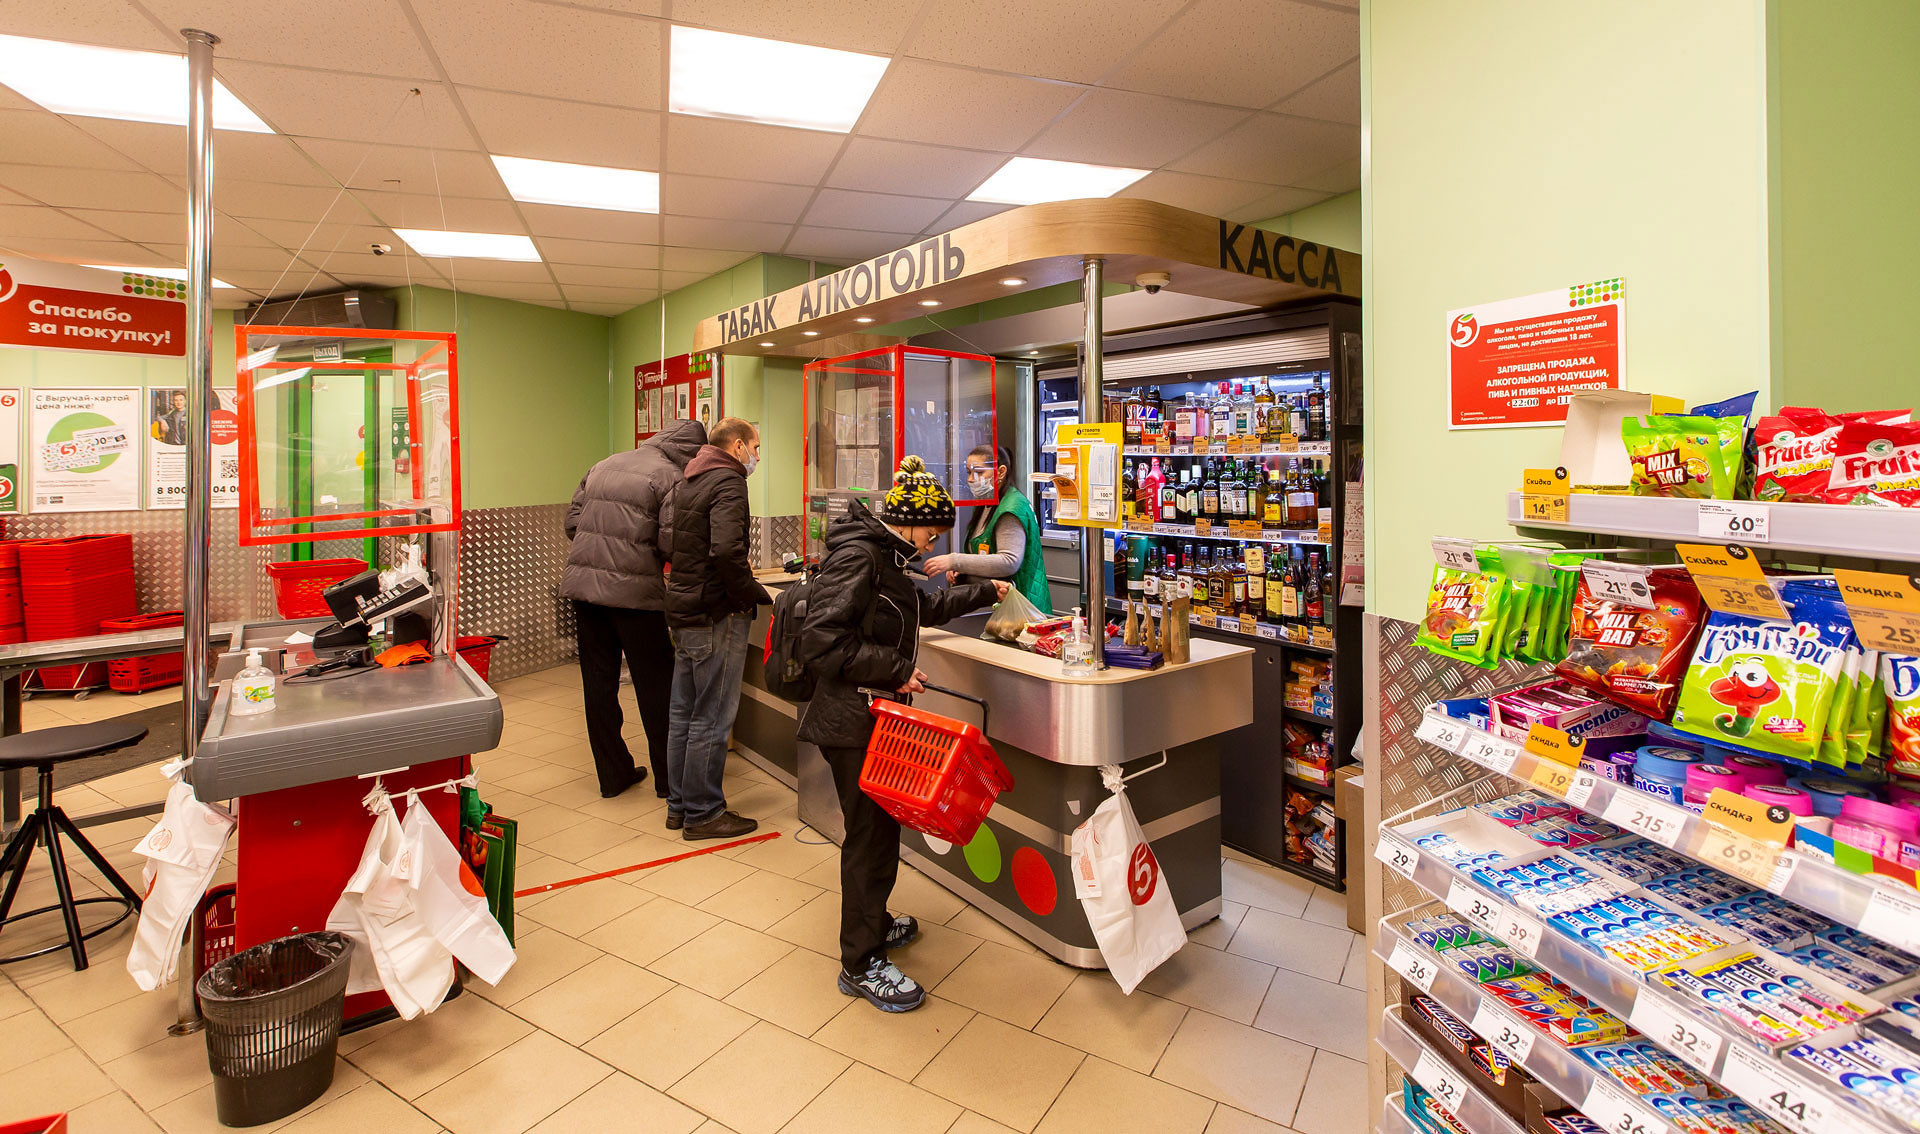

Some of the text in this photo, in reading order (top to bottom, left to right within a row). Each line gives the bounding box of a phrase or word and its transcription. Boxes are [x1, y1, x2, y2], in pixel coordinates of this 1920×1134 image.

[1219, 219, 1342, 292] КАССА
[717, 233, 965, 345] ТАБАК АЛКОГОЛЬ
[28, 299, 132, 323] Спасибо
[1514, 319, 1562, 332] осуществляем
[1563, 313, 1598, 325] продажу
[1575, 320, 1607, 331] изделий
[28, 321, 171, 346] за покупку!
[1530, 336, 1568, 347] достигшим
[1497, 356, 1595, 375] ЗАПРЕЩЕНА ПРОДАЖА
[1486, 368, 1610, 387] АЛКОГОЛЬНОЙ ПРОДУКЦИИ,
[1488, 389, 1510, 398] ПИВА
[1519, 386, 1556, 396] ПИВНЫХ
[1557, 381, 1608, 393] НАПИТКОВ
[1512, 398, 1539, 407] 22:00
[1647, 451, 1677, 472] MIX
[1656, 467, 1685, 485] BAR
[157, 487, 164, 495] 8
[213, 485, 226, 493] 04
[1532, 503, 1545, 514] 14
[1728, 516, 1754, 532] 60
[1444, 551, 1457, 563] 21
[1686, 556, 1728, 566] Скидка
[1445, 583, 1467, 597] MIX
[1604, 580, 1622, 594] 21
[1845, 585, 1904, 599] скидка
[1443, 597, 1468, 611] BAR
[1720, 589, 1747, 605] 33
[1600, 614, 1635, 629] MIX
[1598, 629, 1636, 645] BAR
[1881, 625, 1916, 643] 25
[1437, 728, 1453, 742] 26
[1530, 734, 1560, 749] скидка
[1479, 743, 1494, 757] 19
[1548, 772, 1567, 785] 19
[1710, 802, 1753, 823] скидка
[1630, 811, 1664, 833] 215
[1393, 850, 1409, 866] 29
[1722, 845, 1752, 863] 69
[1471, 900, 1490, 920] 32
[1509, 922, 1527, 940] 39
[1409, 960, 1425, 979] 36
[1433, 1020, 1464, 1051] SNICKERS
[1499, 1027, 1520, 1050] 32
[1671, 1023, 1699, 1052] 32
[1436, 1078, 1454, 1101] 32
[1770, 1091, 1807, 1120] 44
[1619, 1113, 1646, 1134] 36
